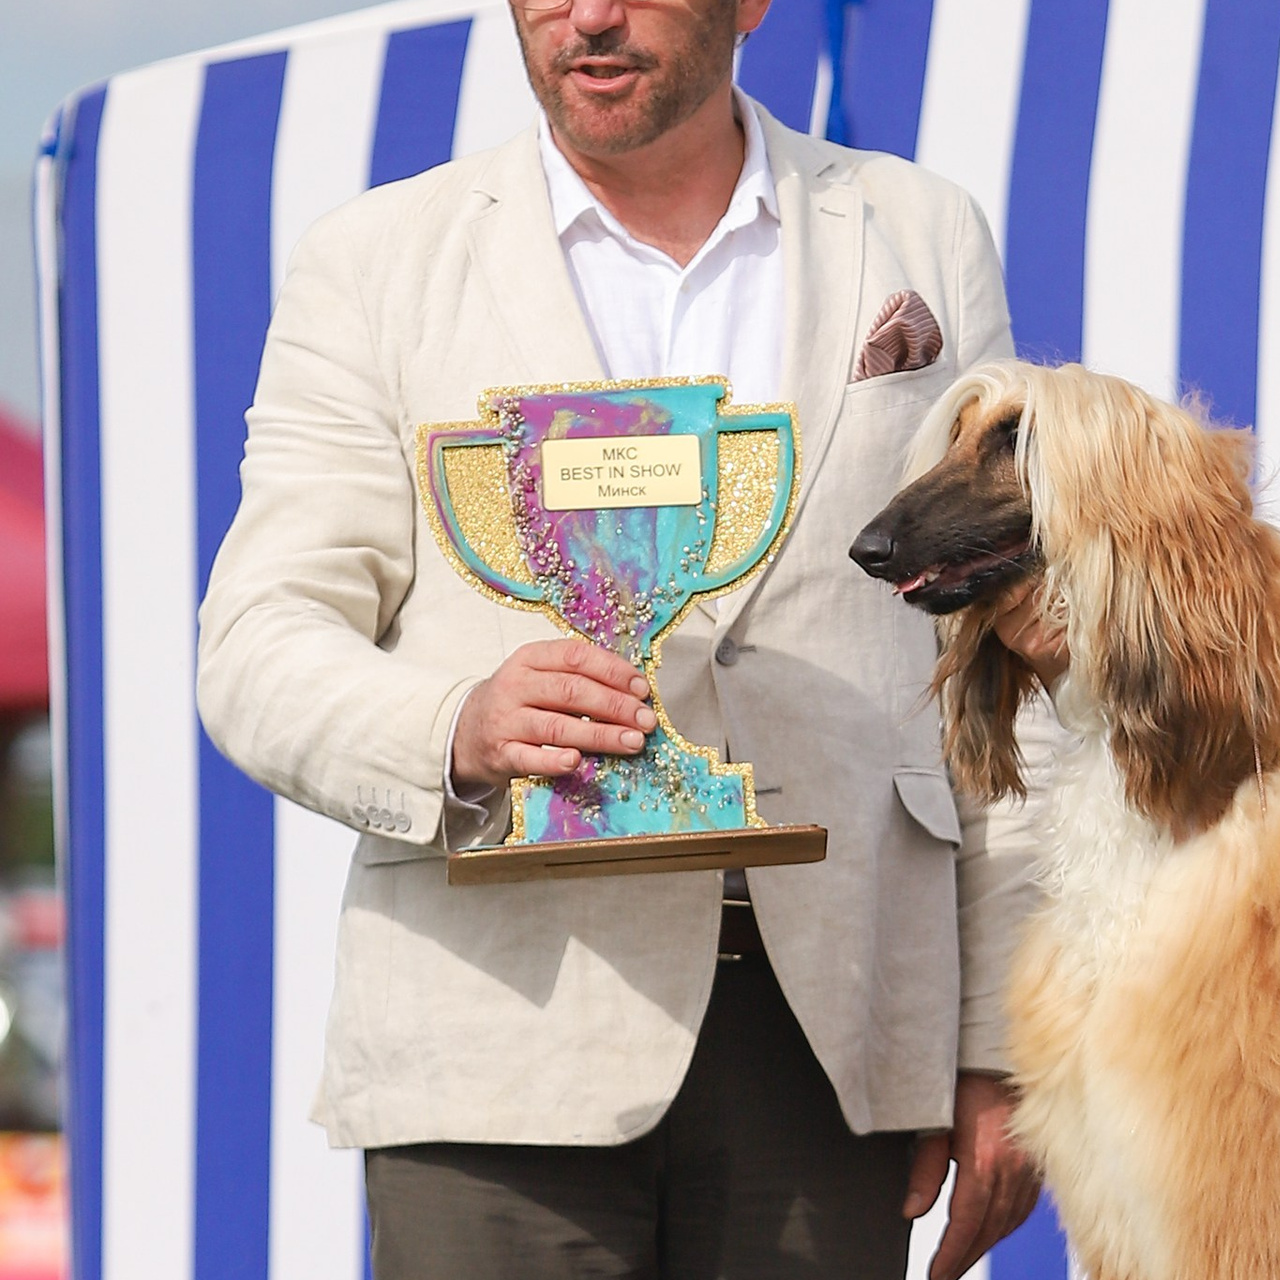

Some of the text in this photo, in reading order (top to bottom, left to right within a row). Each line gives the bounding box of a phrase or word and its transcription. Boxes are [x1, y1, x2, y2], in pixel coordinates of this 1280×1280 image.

[561, 464, 682, 481] BEST IN SHOW
[598, 485, 646, 498] Минск
